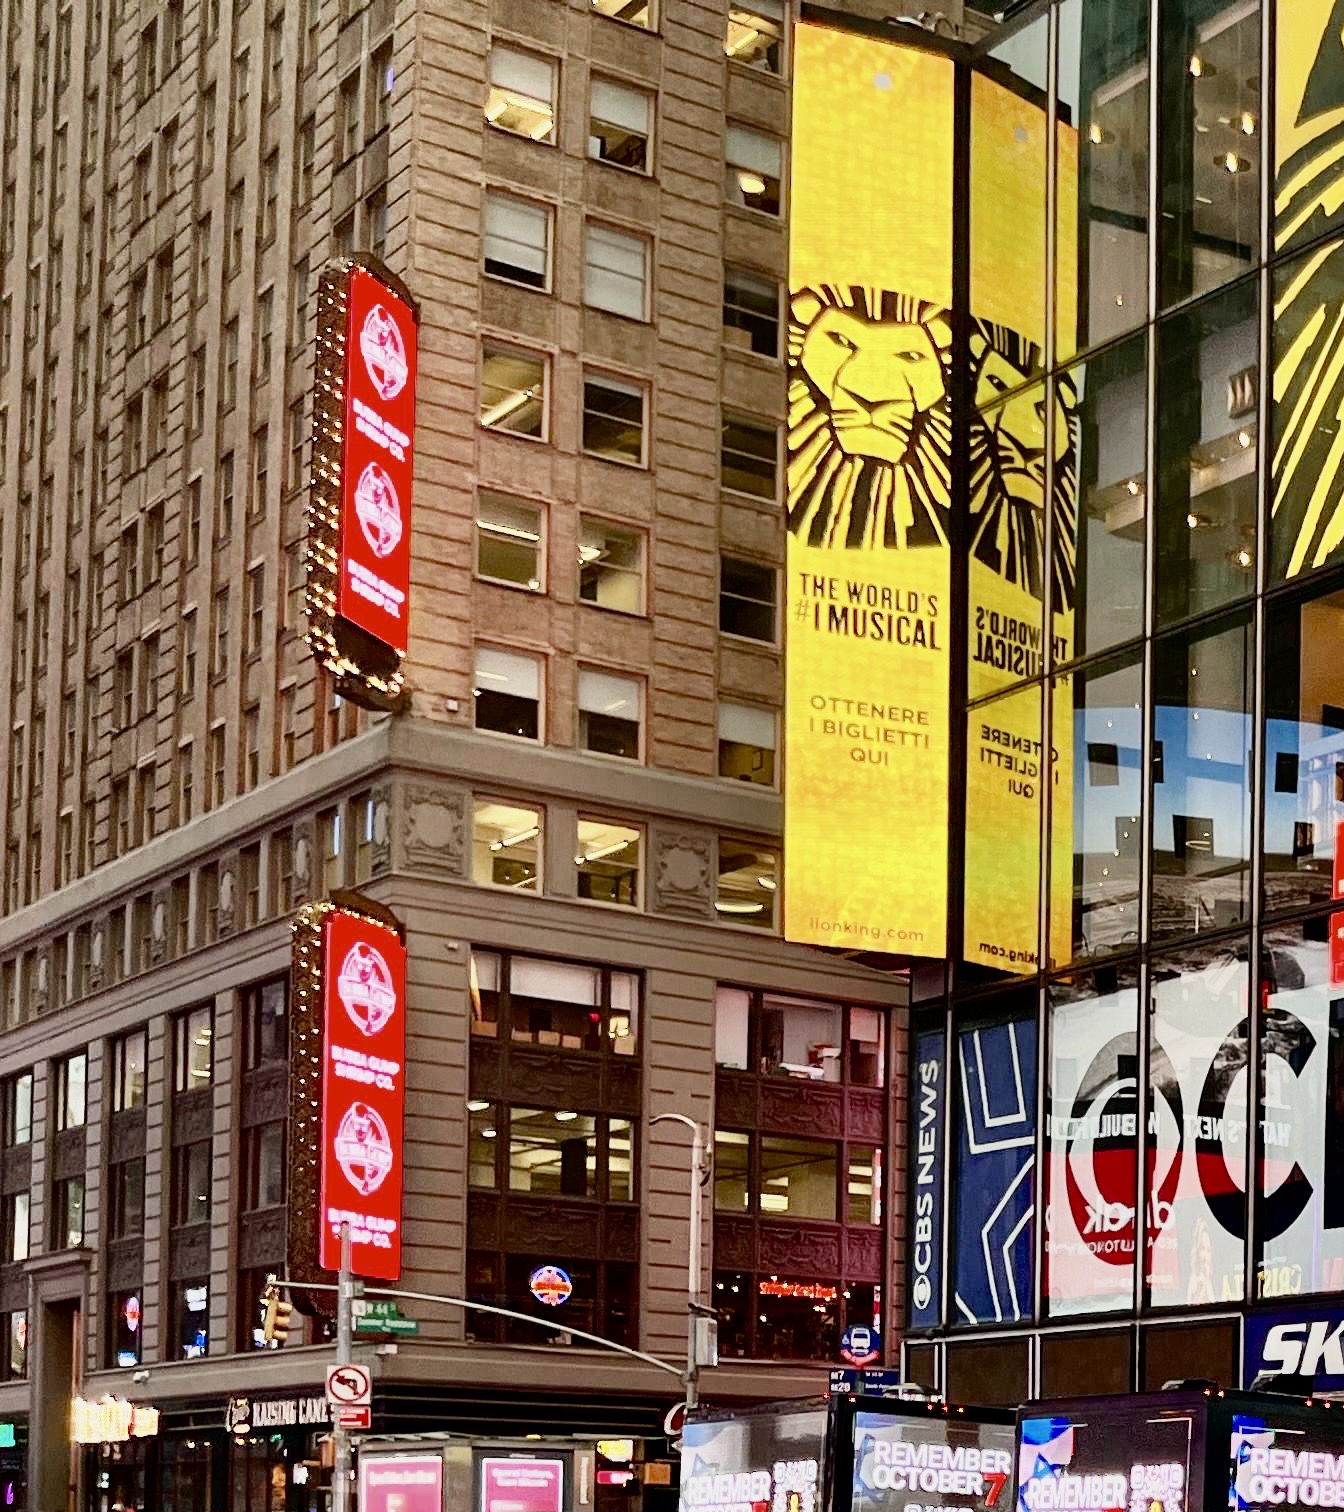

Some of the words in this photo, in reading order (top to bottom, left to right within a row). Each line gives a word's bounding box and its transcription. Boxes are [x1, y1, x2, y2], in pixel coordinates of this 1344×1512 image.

[799, 573, 840, 600] THE
[847, 580, 938, 618] WORLD'S
[828, 604, 942, 651] MUSICAL
[810, 695, 930, 726] OTTENERE
[823, 720, 930, 750] BIGLIETTI
[849, 748, 889, 767] QUI
[808, 916, 924, 943] lionking.com
[917, 1059, 938, 1185] NEWS
[914, 1192, 932, 1273] CBS
[874, 1441, 1011, 1475] REMEMBER
[688, 1471, 771, 1505] REMEMBER
[872, 1465, 983, 1495] OCTOBER
[982, 1472, 1008, 1507] 7
[1028, 1476, 1127, 1509] REMEMBER
